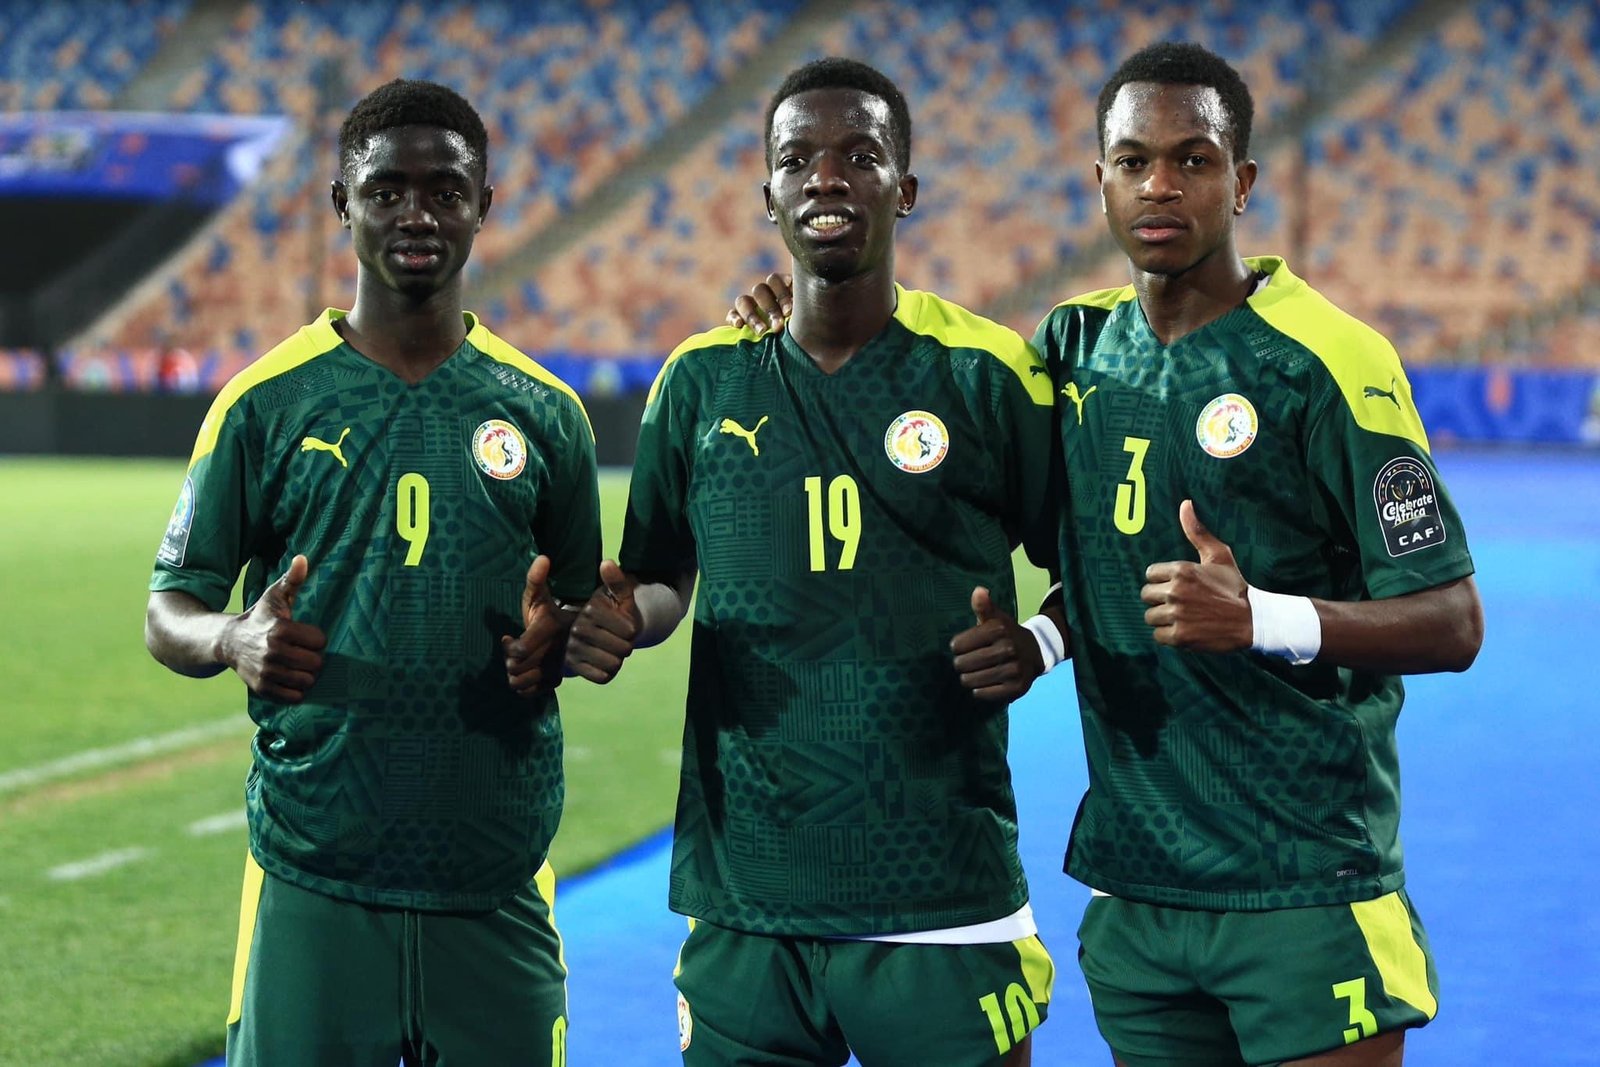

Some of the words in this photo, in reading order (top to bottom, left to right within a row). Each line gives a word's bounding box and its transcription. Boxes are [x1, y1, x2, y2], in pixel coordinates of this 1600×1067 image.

[396, 472, 430, 566] 9
[1114, 436, 1150, 535] 3
[1382, 494, 1433, 521] Celebrate
[1394, 507, 1426, 526] Africa
[804, 474, 862, 571] 19
[1398, 527, 1434, 546] CAF
[979, 982, 1040, 1055] 10
[1332, 976, 1378, 1044] 3
